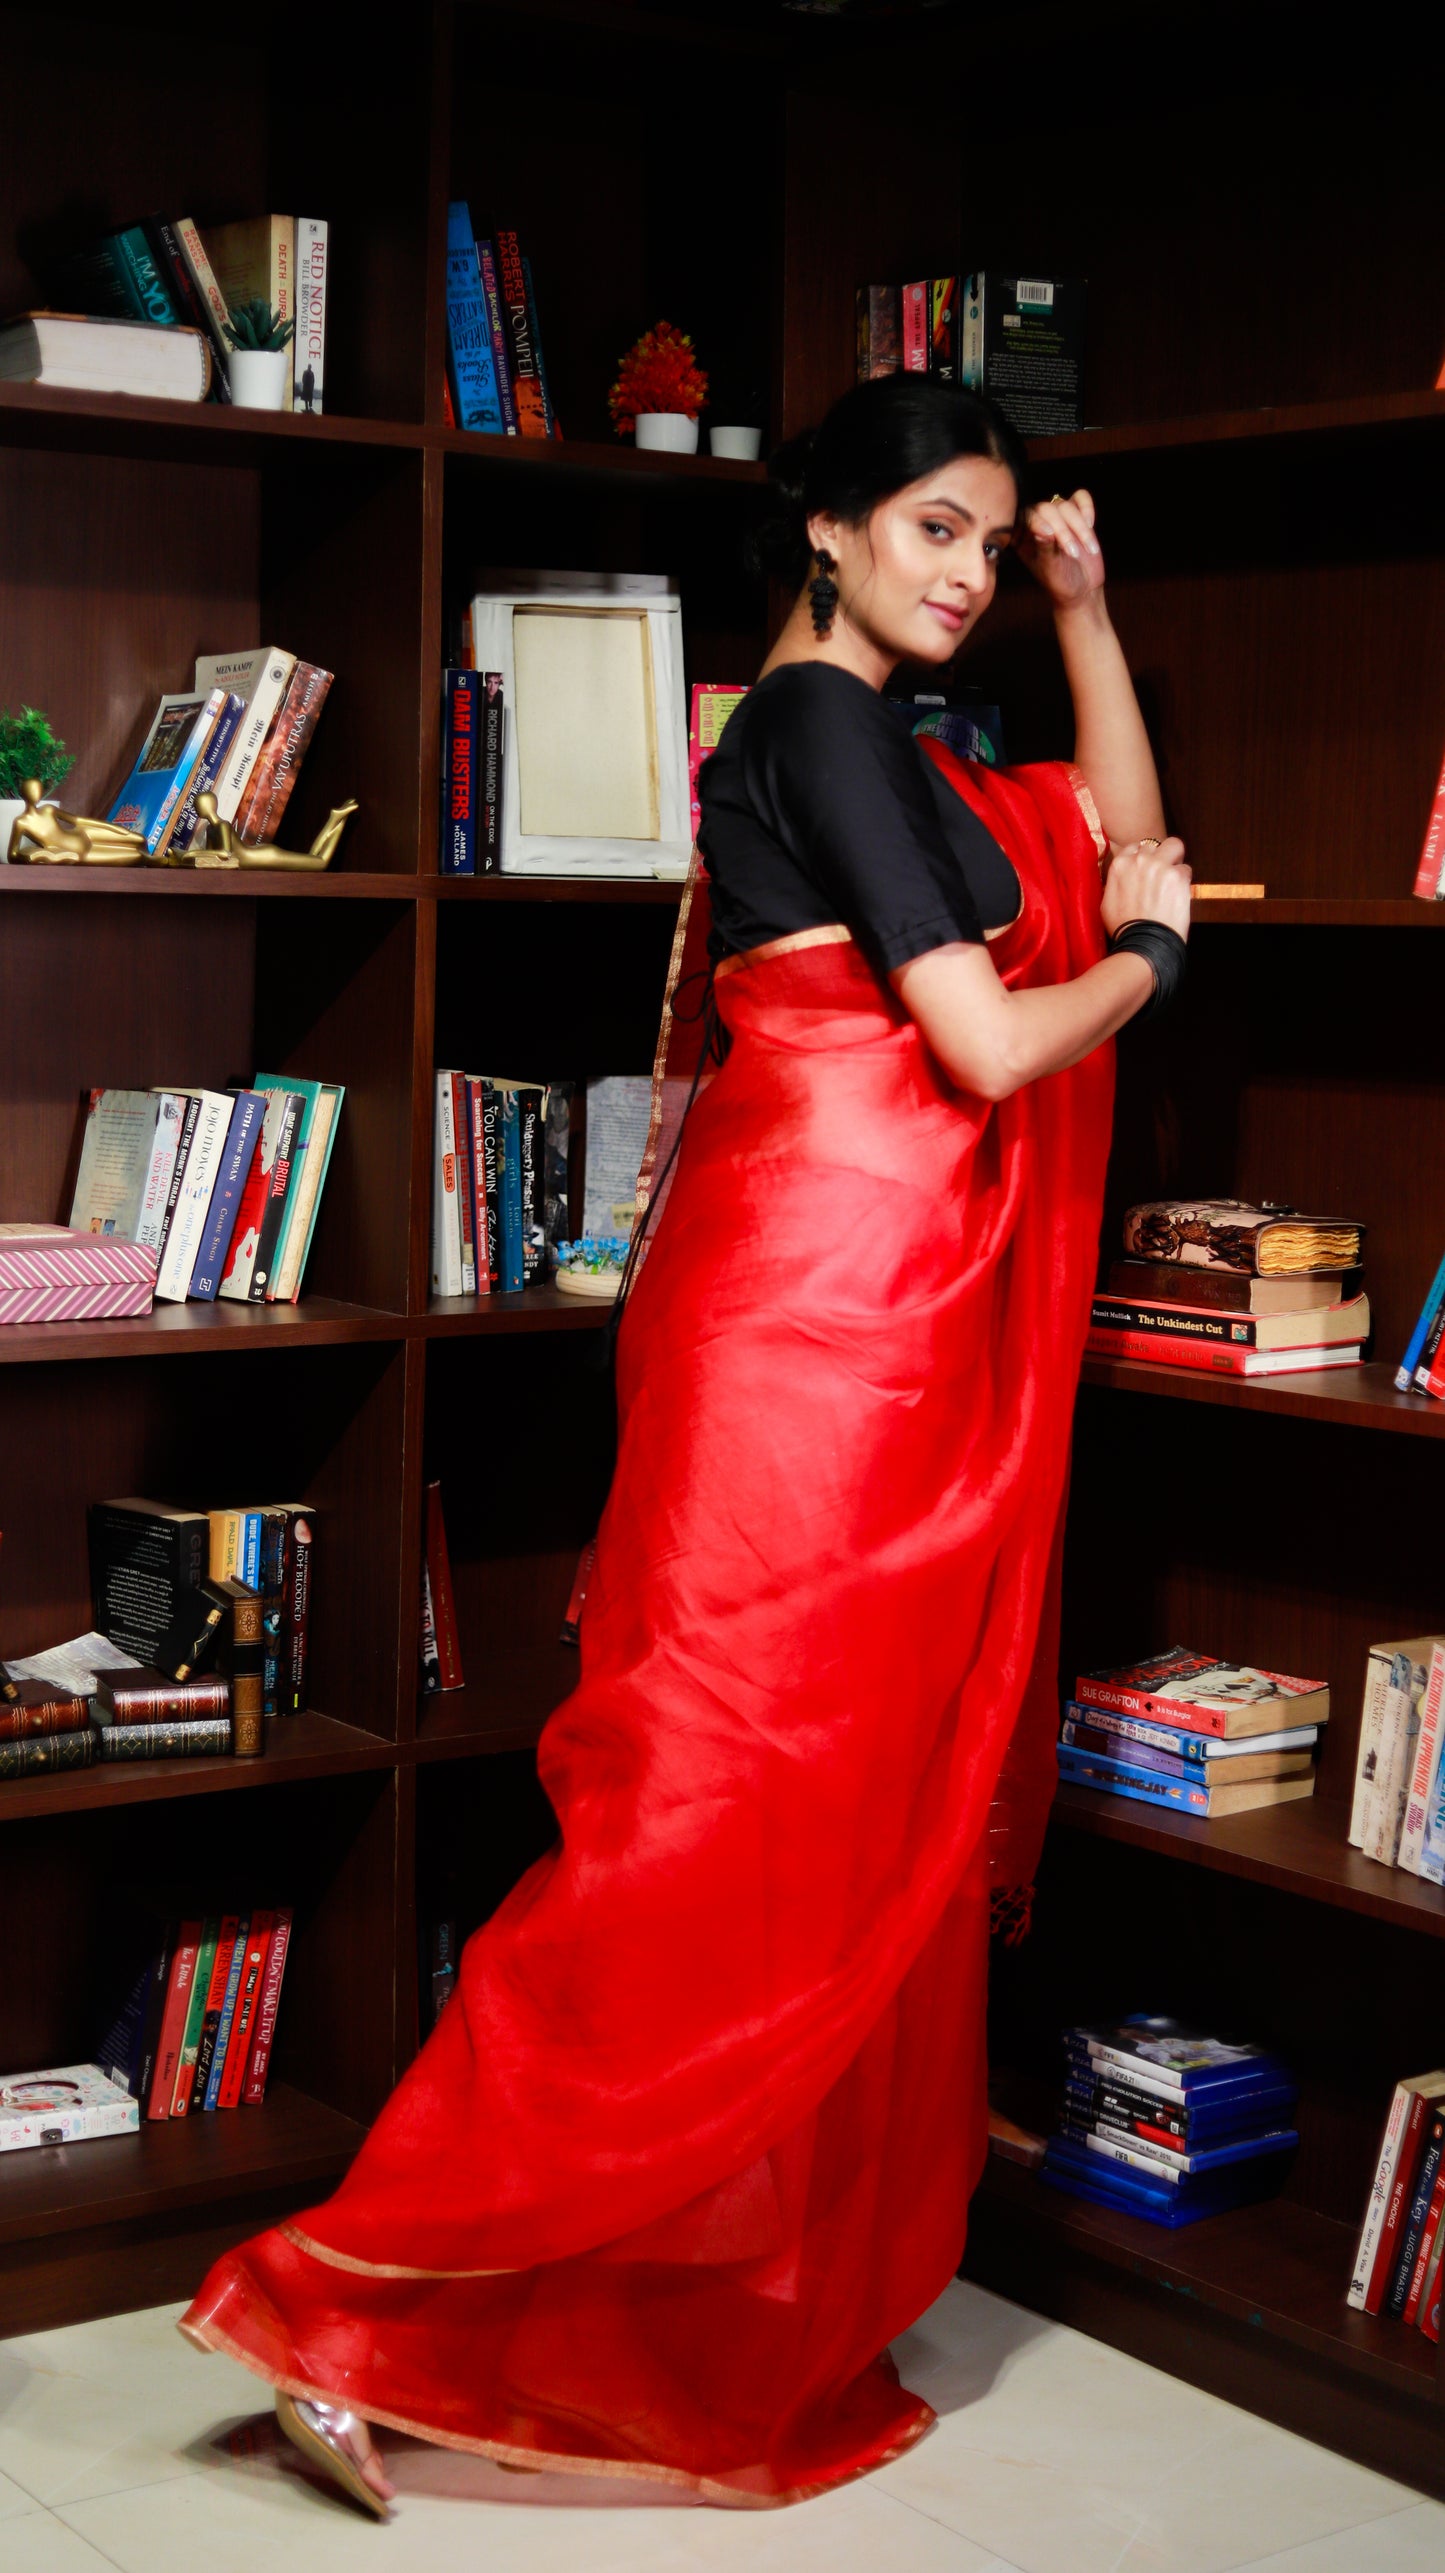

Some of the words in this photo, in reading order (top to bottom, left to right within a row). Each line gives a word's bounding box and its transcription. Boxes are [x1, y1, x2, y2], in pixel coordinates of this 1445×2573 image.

[161, 224, 174, 245] End
[120, 234, 148, 292] WATCHING
[278, 243, 288, 280] DEATH
[302, 258, 310, 283] BILL
[312, 240, 324, 281] RED
[496, 232, 515, 304] HARRIS
[506, 231, 526, 301] ROBERT
[299, 284, 309, 337] BROWDER
[309, 285, 323, 361] NOTICE
[487, 293, 502, 332] BACHELOR
[454, 321, 490, 351] DREAM
[509, 304, 534, 380] POMPEII
[496, 355, 510, 397] RAVINDER
[502, 397, 512, 422] SINGH
[301, 682, 317, 714] AMISH
[453, 689, 471, 733] DAM
[487, 708, 499, 752] RICHARD
[209, 745, 221, 765] DALE
[271, 712, 308, 792] VAYUPUTRAS
[451, 737, 471, 821] BUSTERS
[485, 753, 498, 803] HAMMOND
[453, 824, 461, 868] HOLLAND
[459, 829, 467, 861] JAMES
[187, 1107, 199, 1132] BOUGHT
[243, 1102, 255, 1129] PATH
[289, 1111, 297, 1131] UDAY
[484, 1106, 496, 1134] YOU
[183, 1132, 193, 1148] THE
[282, 1131, 295, 1166] SATPATHY
[485, 1136, 497, 1167] CAN
[521, 1112, 536, 1169] Skulduggery
[152, 1150, 163, 1174] AND
[164, 1151, 174, 1173] KILL
[178, 1148, 189, 1174] MONK'S
[195, 1133, 217, 1184] moyes
[228, 1155, 241, 1183] SWAN
[445, 1156, 454, 1190] SALES
[474, 1097, 482, 1137] Searching
[478, 1206, 486, 1223] Billy
[145, 1175, 159, 1211] WATER
[157, 1174, 170, 1205] DEVIL
[168, 1174, 182, 1208] FERRARI
[270, 1158, 291, 1199] BRUTAL
[486, 1168, 498, 1194] WIN
[523, 1169, 536, 1211] Pleasant
[215, 1207, 229, 1234] CHARU
[207, 1236, 222, 1263] SINGH
[1137, 1312, 1155, 1327] The
[1156, 1316, 1205, 1335] Unkindest
[1206, 1324, 1224, 1336] Cut
[296, 1544, 306, 1569] HOT
[293, 1570, 305, 1621] BLOODED
[268, 1660, 277, 1690] HELEN
[1081, 1685, 1097, 1700] SUE
[1097, 1689, 1140, 1711] GRAFTON
[1423, 1667, 1444, 1734] ACCIDENTAL
[1412, 1736, 1435, 1798] APPRENTICE
[1406, 1802, 1418, 1835] SWARUP
[1415, 1807, 1425, 1831] VIKAS
[235, 1936, 248, 1964] WHEN
[210, 1977, 224, 2006] SHAN
[228, 1972, 238, 1997] GROW
[246, 1966, 257, 1994] TIMMY
[263, 1985, 277, 2016] MAKE
[221, 2017, 232, 2043] WANT
[201, 2037, 213, 2067] Lord
[1115, 2070, 1128, 2082] FIFA
[1115, 2150, 1129, 2163] FIFA
[1394, 2181, 1404, 2198] THE
[1388, 2198, 1400, 2230] CHOICE
[1401, 2229, 1417, 2262] JUGGI
[1391, 2262, 1407, 2306] BHASIN
